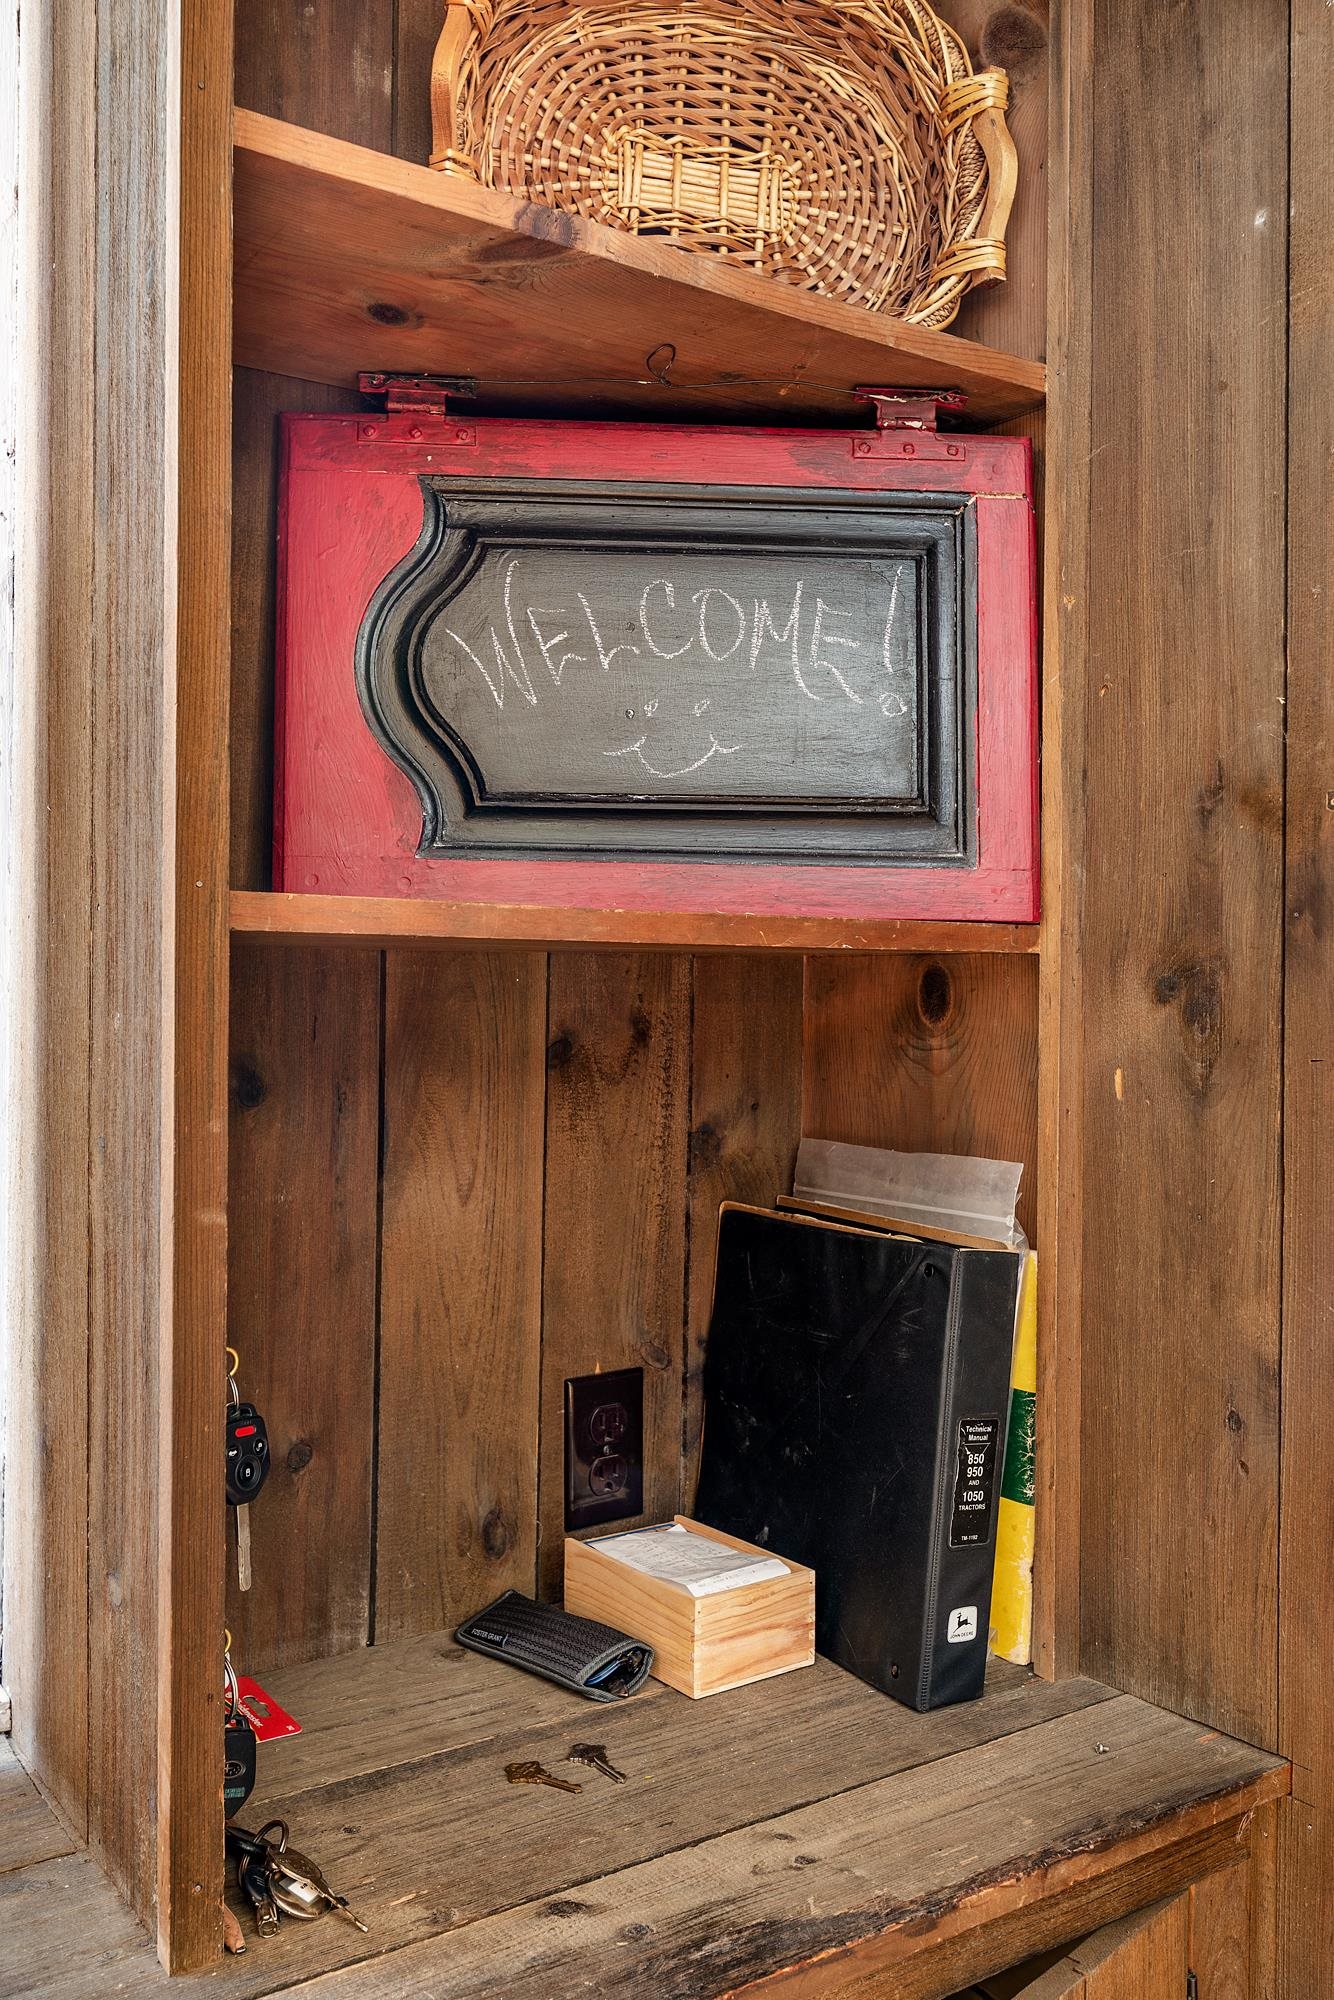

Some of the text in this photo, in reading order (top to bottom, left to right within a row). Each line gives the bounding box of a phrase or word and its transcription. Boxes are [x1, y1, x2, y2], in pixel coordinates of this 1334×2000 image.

[445, 560, 908, 717] WELCOME!
[966, 1425, 993, 1433] Technical
[968, 1433, 989, 1441] Manual
[967, 1453, 985, 1465] 850
[966, 1466, 984, 1478] 950
[962, 1491, 984, 1502] 1050
[471, 1628, 503, 1642] FOSTER GRANT
